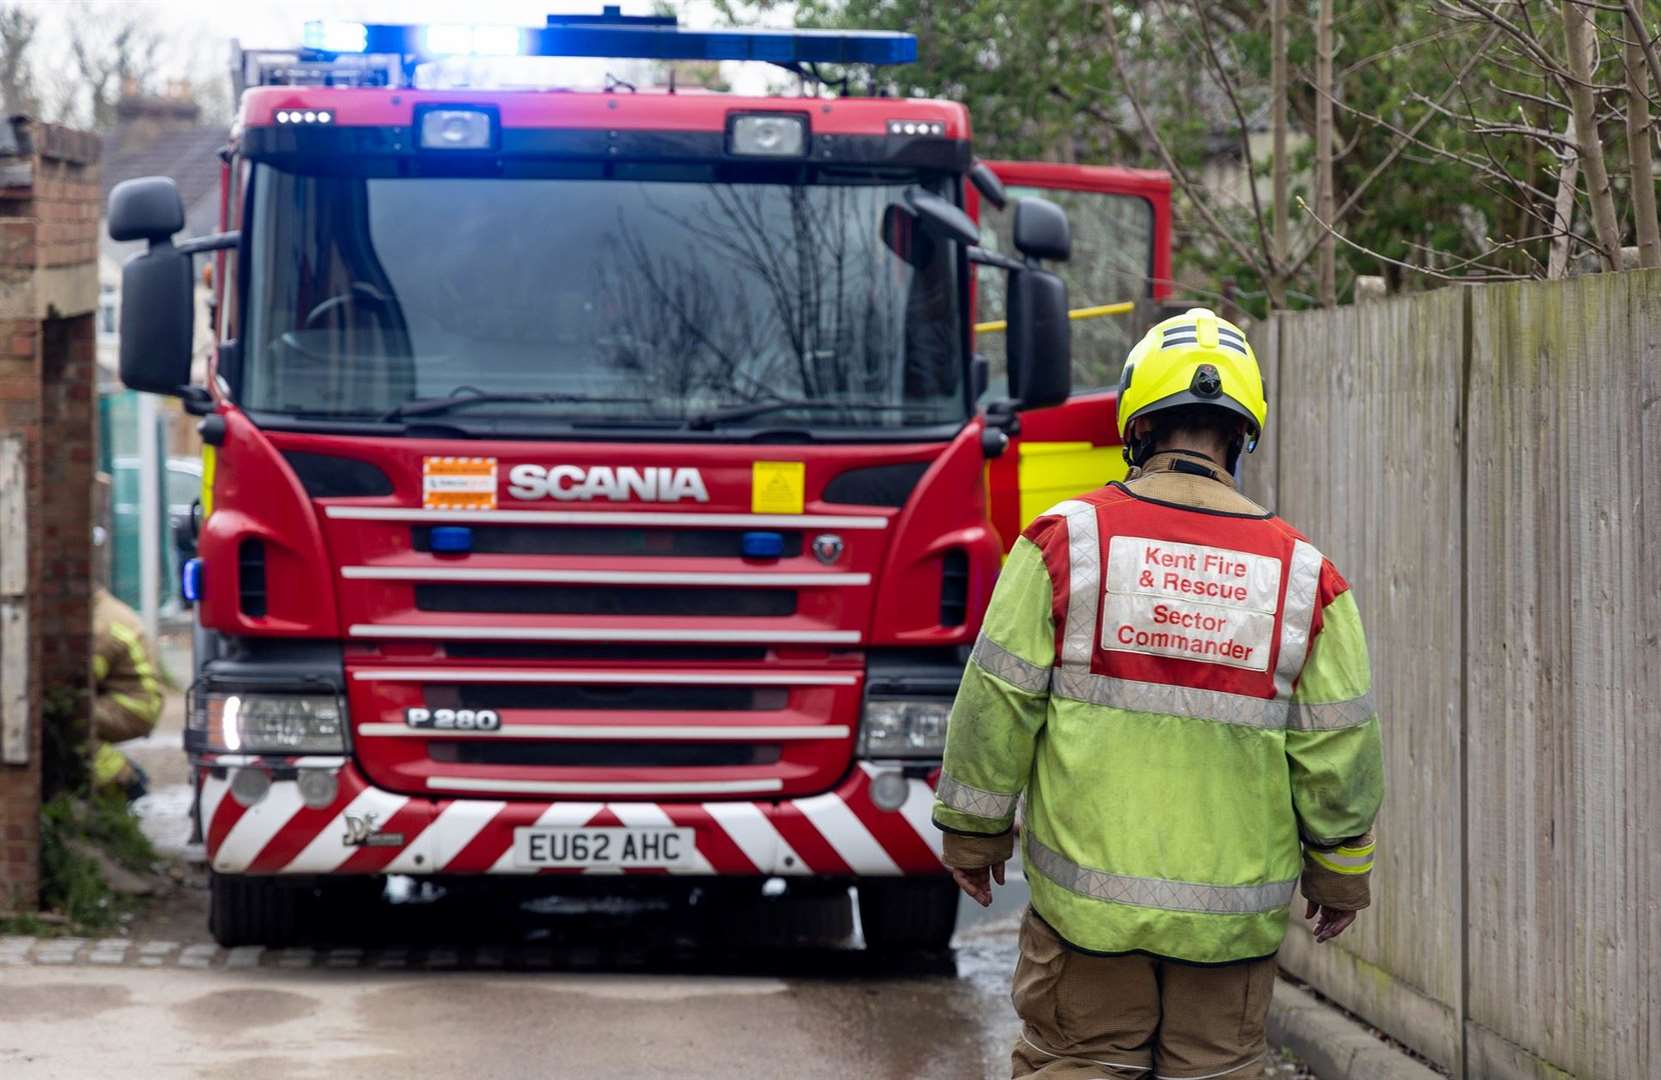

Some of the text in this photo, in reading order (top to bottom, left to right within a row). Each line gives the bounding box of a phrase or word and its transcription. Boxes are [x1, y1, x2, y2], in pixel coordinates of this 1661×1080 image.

[508, 464, 710, 502] SCANIA
[1145, 547, 1247, 577] Kent Fire
[1139, 570, 1248, 600] & Rescue
[1153, 604, 1227, 632] Sector
[1118, 625, 1253, 660] Commander
[408, 708, 498, 730] P 280
[529, 834, 680, 861] EU62 AHC
